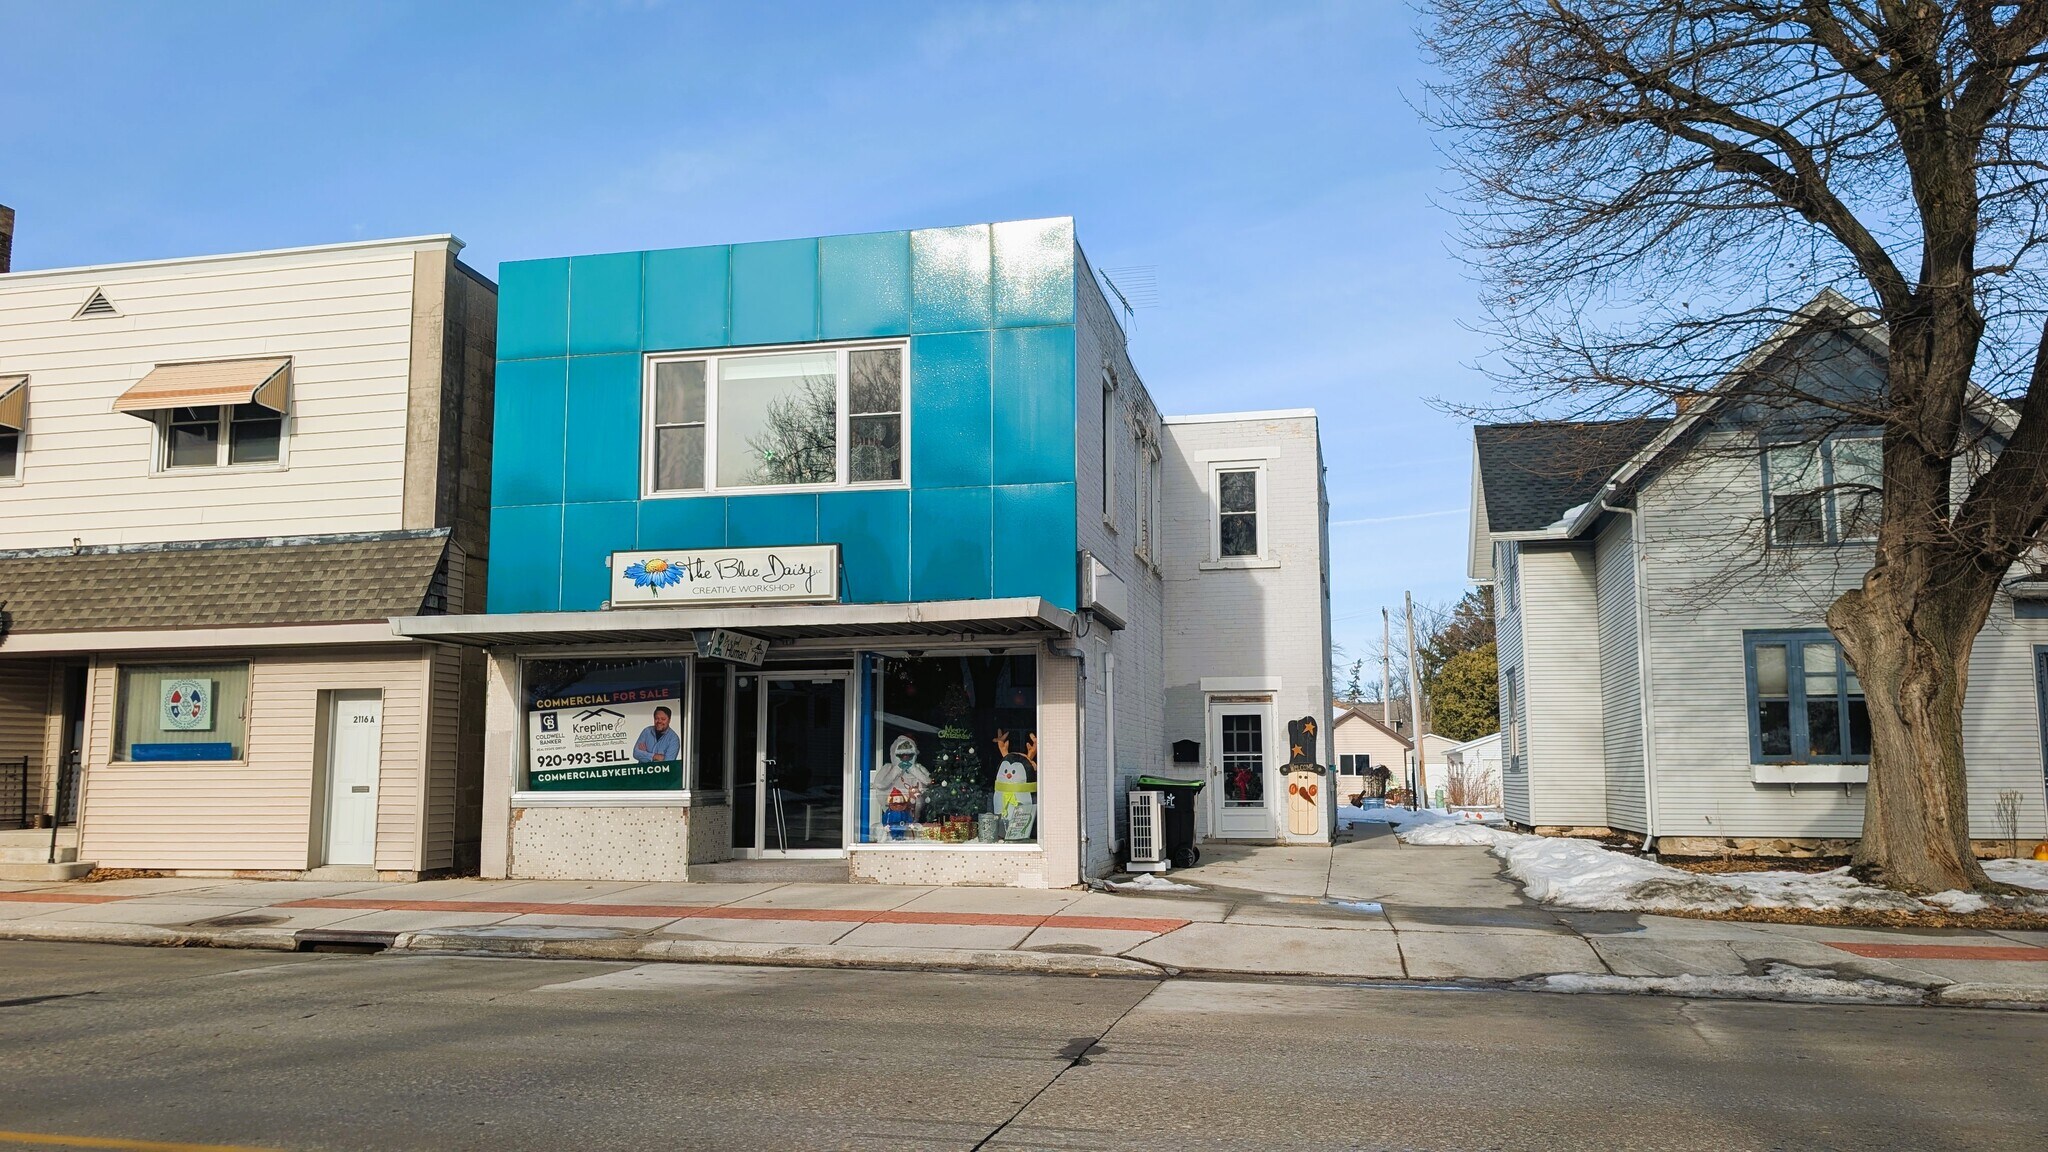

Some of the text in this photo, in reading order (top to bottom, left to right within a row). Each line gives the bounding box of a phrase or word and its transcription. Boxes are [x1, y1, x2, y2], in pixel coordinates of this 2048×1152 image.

[675, 556, 712, 582] The
[714, 558, 760, 580] Blue
[762, 554, 816, 594] Daisy
[692, 583, 796, 595] CREATIVE WORKSHOP
[536, 688, 669, 709] COMMERCIAL FOR SALE
[353, 715, 375, 723] 2116 A
[572, 721, 614, 735] Krepline
[535, 733, 566, 741] COLDWELL
[574, 731, 627, 741] Associates.com
[537, 749, 630, 768] 920-993-SELL
[538, 765, 670, 782] COMMERCIALBYKEITH.COM
